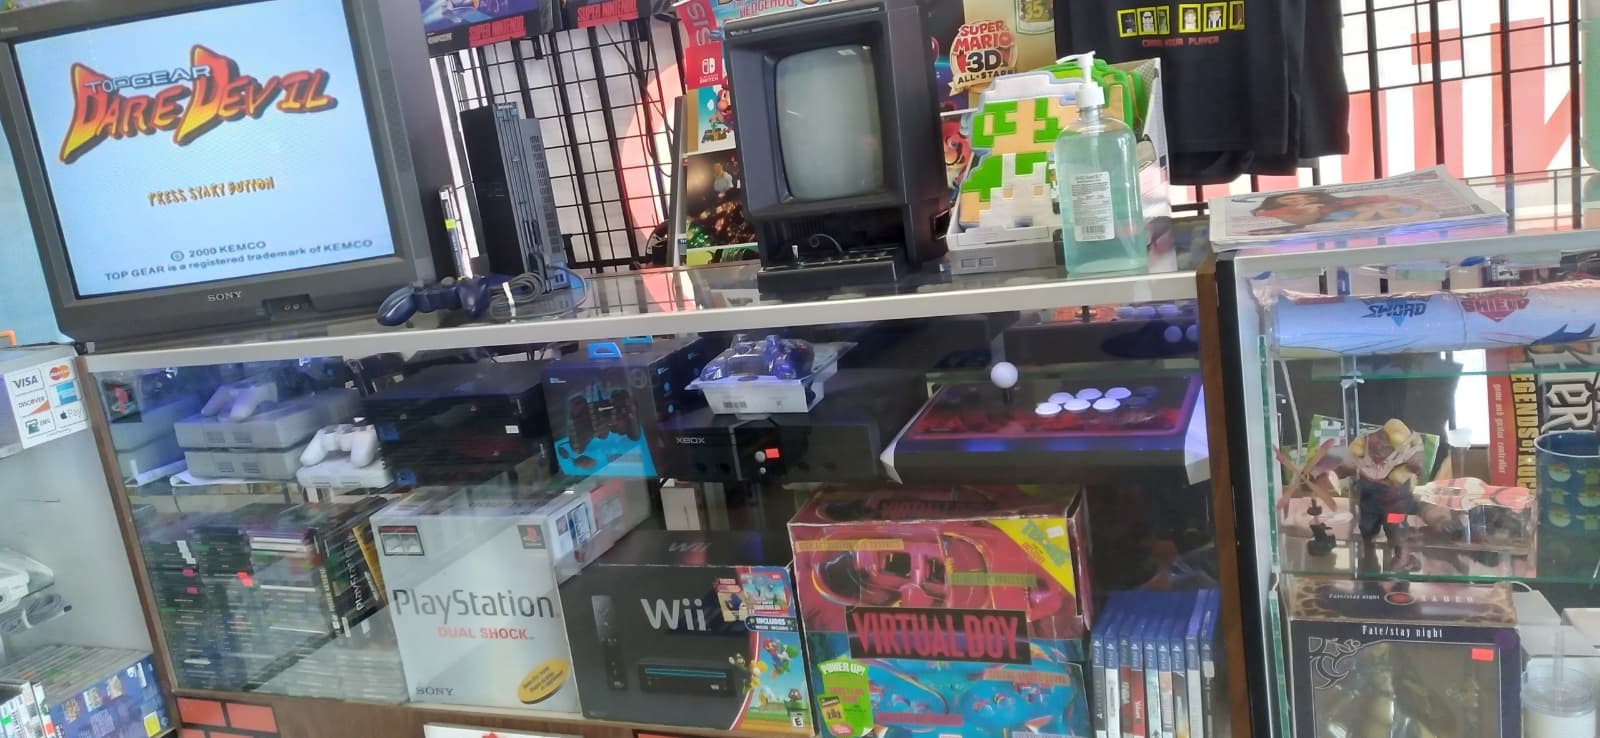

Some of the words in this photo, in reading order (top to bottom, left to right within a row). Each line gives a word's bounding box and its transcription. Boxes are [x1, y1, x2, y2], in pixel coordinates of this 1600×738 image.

[960, 20, 1004, 36] SUPER
[953, 31, 1013, 52] MARIO
[966, 48, 1002, 73] 3D
[147, 188, 187, 206] PRESS
[188, 182, 225, 201] START
[227, 176, 275, 195] BUTTON
[189, 247, 217, 258] 2000
[219, 241, 267, 253] KEMCO
[104, 270, 128, 281] TOP
[131, 265, 164, 277] GEAR
[167, 262, 177, 271] is
[179, 262, 187, 270] a
[188, 255, 245, 269] registered
[247, 247, 307, 260] trademark
[309, 245, 321, 254] of
[324, 239, 373, 252] KEMCO
[207, 290, 242, 302] SONY
[1360, 302, 1427, 319] SWORD
[11, 375, 38, 388] VISA
[67, 408, 82, 419] Pay
[1495, 418, 1505, 439] guitar
[1497, 442, 1508, 473] controller
[392, 588, 555, 625] PlayStation
[640, 598, 707, 632] Wii
[437, 626, 476, 640] DUAL
[852, 611, 964, 658] VIRTUAL
[964, 614, 1018, 660] BOY
[1362, 625, 1411, 638] Fate/stay
[1416, 626, 1443, 639] night
[821, 661, 850, 675] POWER
[850, 663, 866, 676] UP!
[416, 686, 454, 697] SONY
